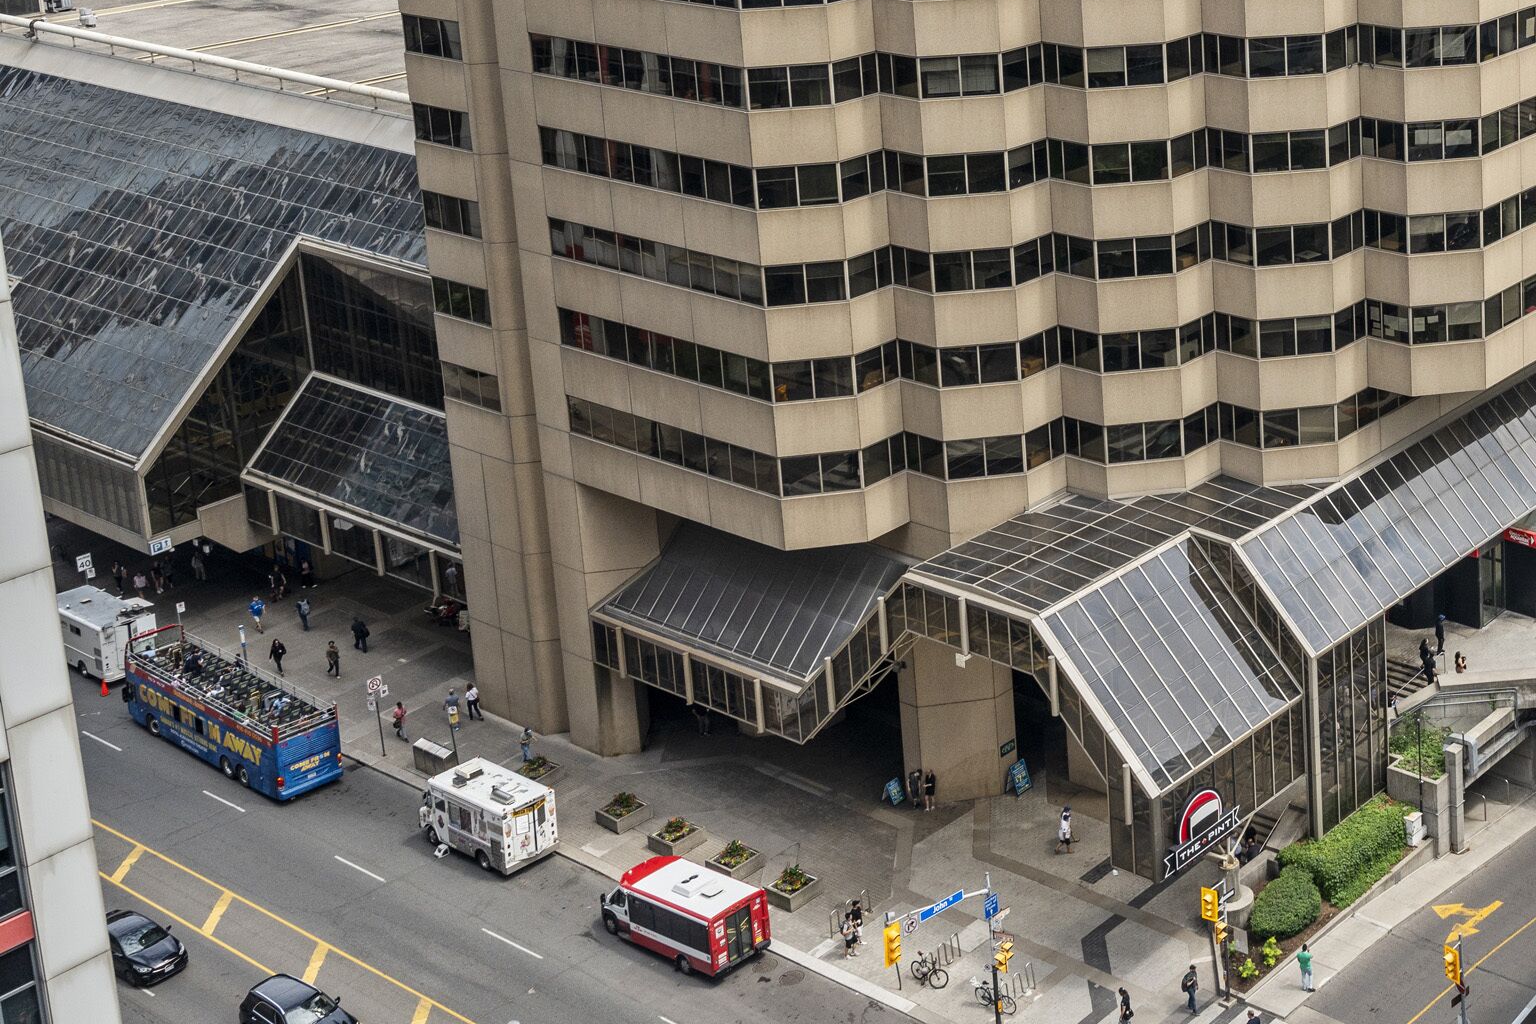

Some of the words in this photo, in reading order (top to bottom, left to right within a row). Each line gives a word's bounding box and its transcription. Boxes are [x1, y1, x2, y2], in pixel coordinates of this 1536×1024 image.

[79, 559, 91, 569] 40
[179, 705, 221, 744] FRM
[223, 731, 262, 766] AWAY
[1179, 840, 1201, 861] THE
[1207, 818, 1231, 841] PINT
[932, 901, 948, 914] John
